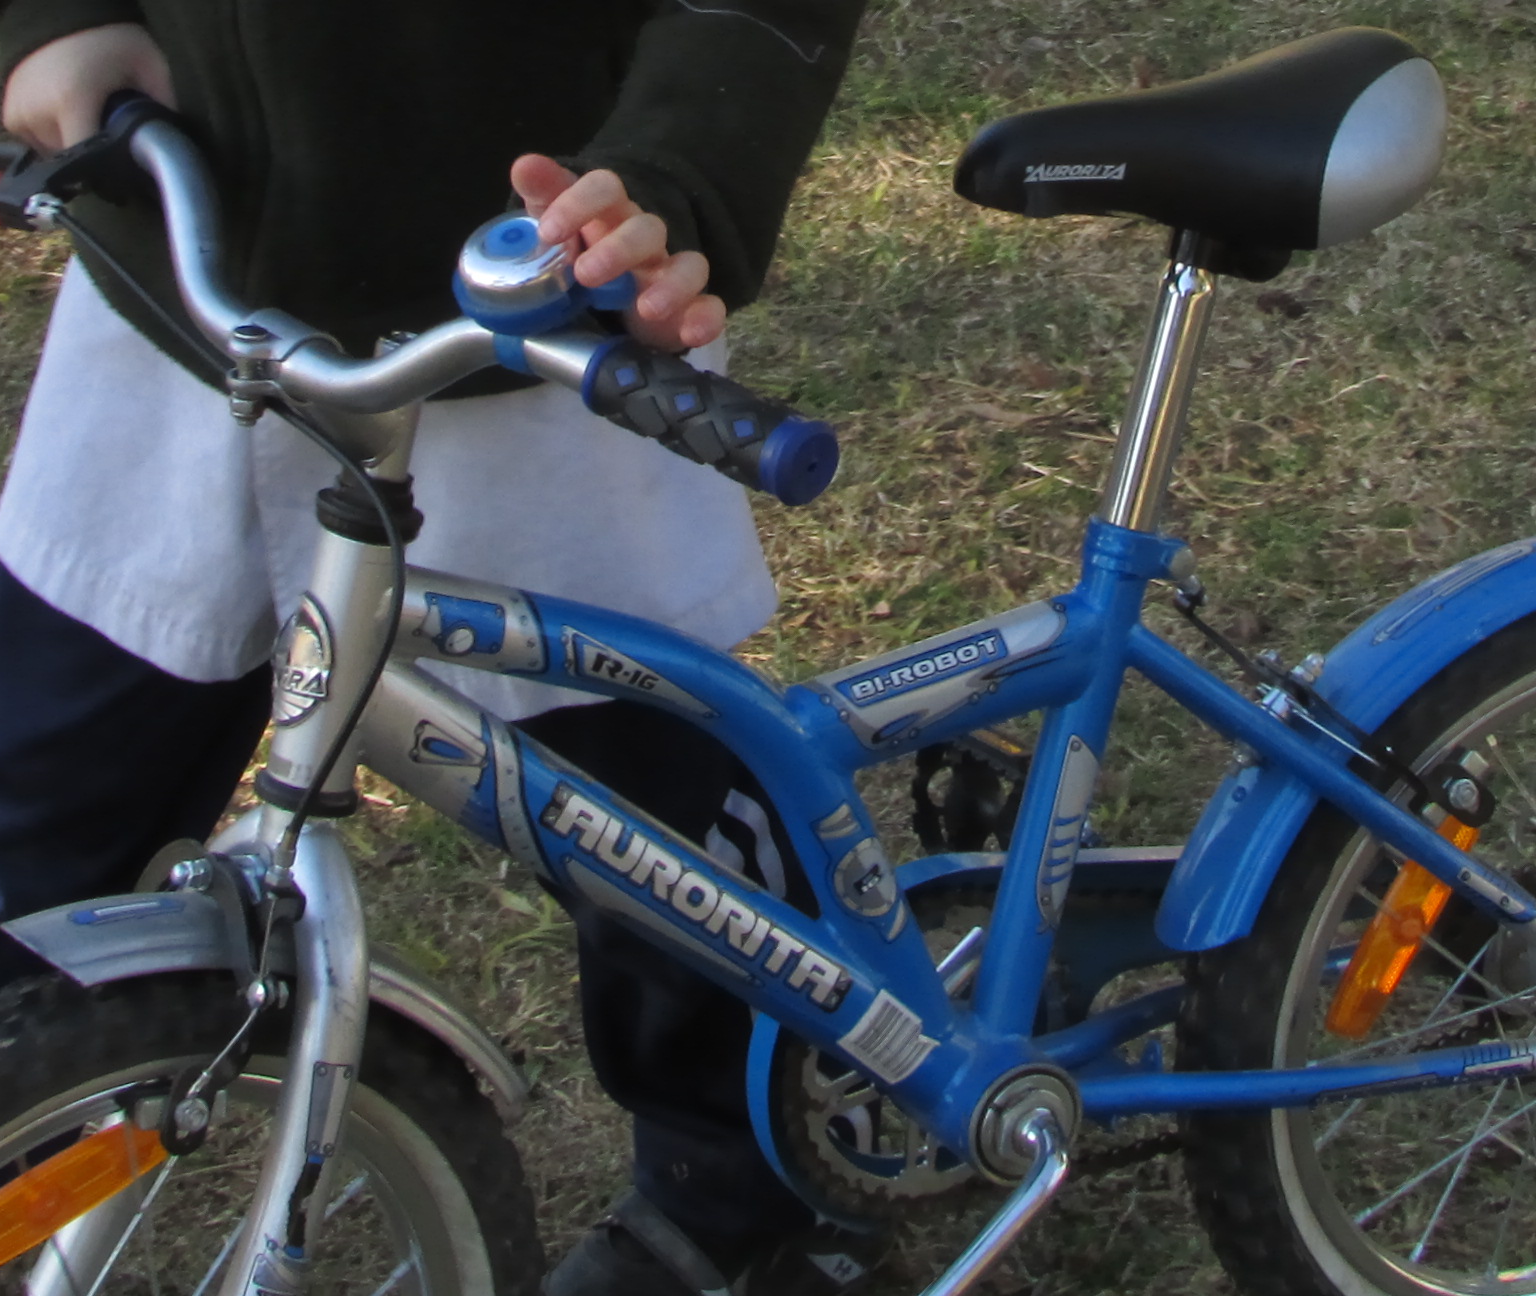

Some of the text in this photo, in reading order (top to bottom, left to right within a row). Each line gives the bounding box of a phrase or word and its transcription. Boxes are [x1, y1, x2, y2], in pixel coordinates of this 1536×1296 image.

[1023, 162, 1127, 182] AURORITA
[851, 636, 1000, 701] BI-ROBOT
[554, 794, 844, 1006] AURORITA
